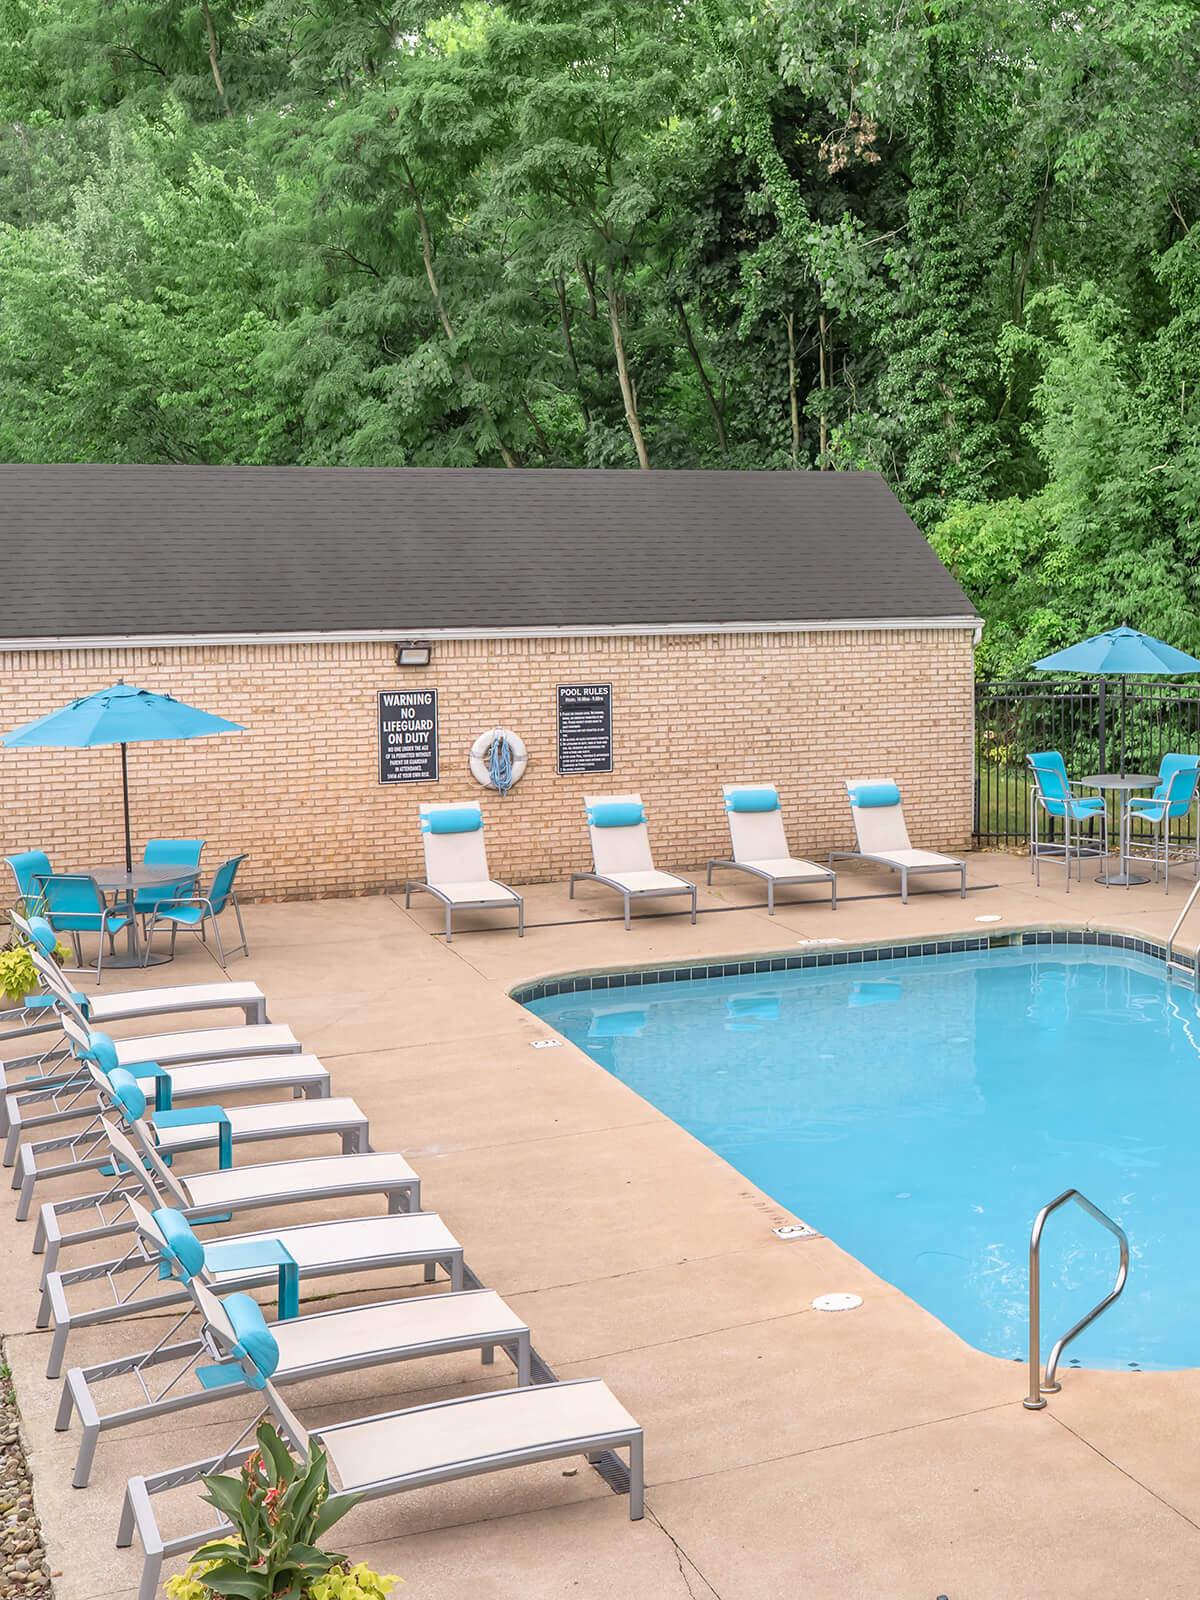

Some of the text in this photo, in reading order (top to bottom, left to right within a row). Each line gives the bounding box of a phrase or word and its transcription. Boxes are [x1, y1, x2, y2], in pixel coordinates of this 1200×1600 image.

[560, 687, 609, 696] POOL RULES
[383, 693, 432, 706] WARNING
[401, 708, 415, 719] NO
[383, 720, 433, 732] LIFEGUARD
[388, 732, 430, 744] ON DUTY
